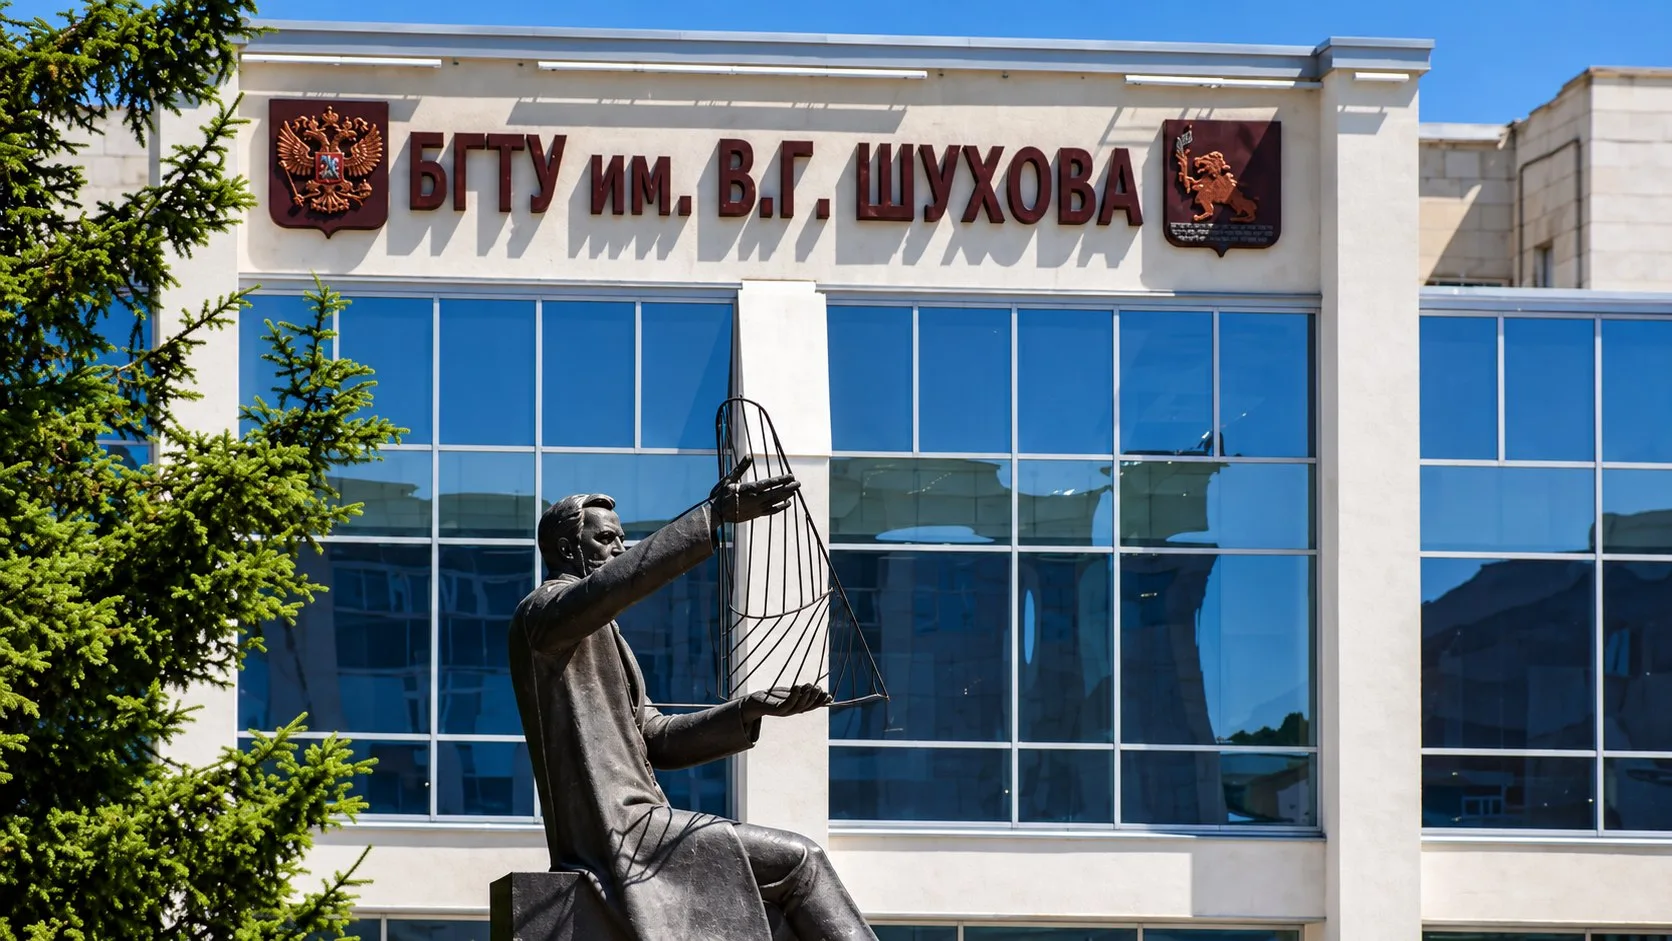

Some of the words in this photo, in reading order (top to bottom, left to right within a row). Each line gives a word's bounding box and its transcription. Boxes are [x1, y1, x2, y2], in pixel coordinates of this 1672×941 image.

[409, 131, 567, 213] БГТУ
[718, 138, 831, 219] В.Г.
[855, 142, 1143, 227] ШУХОВА
